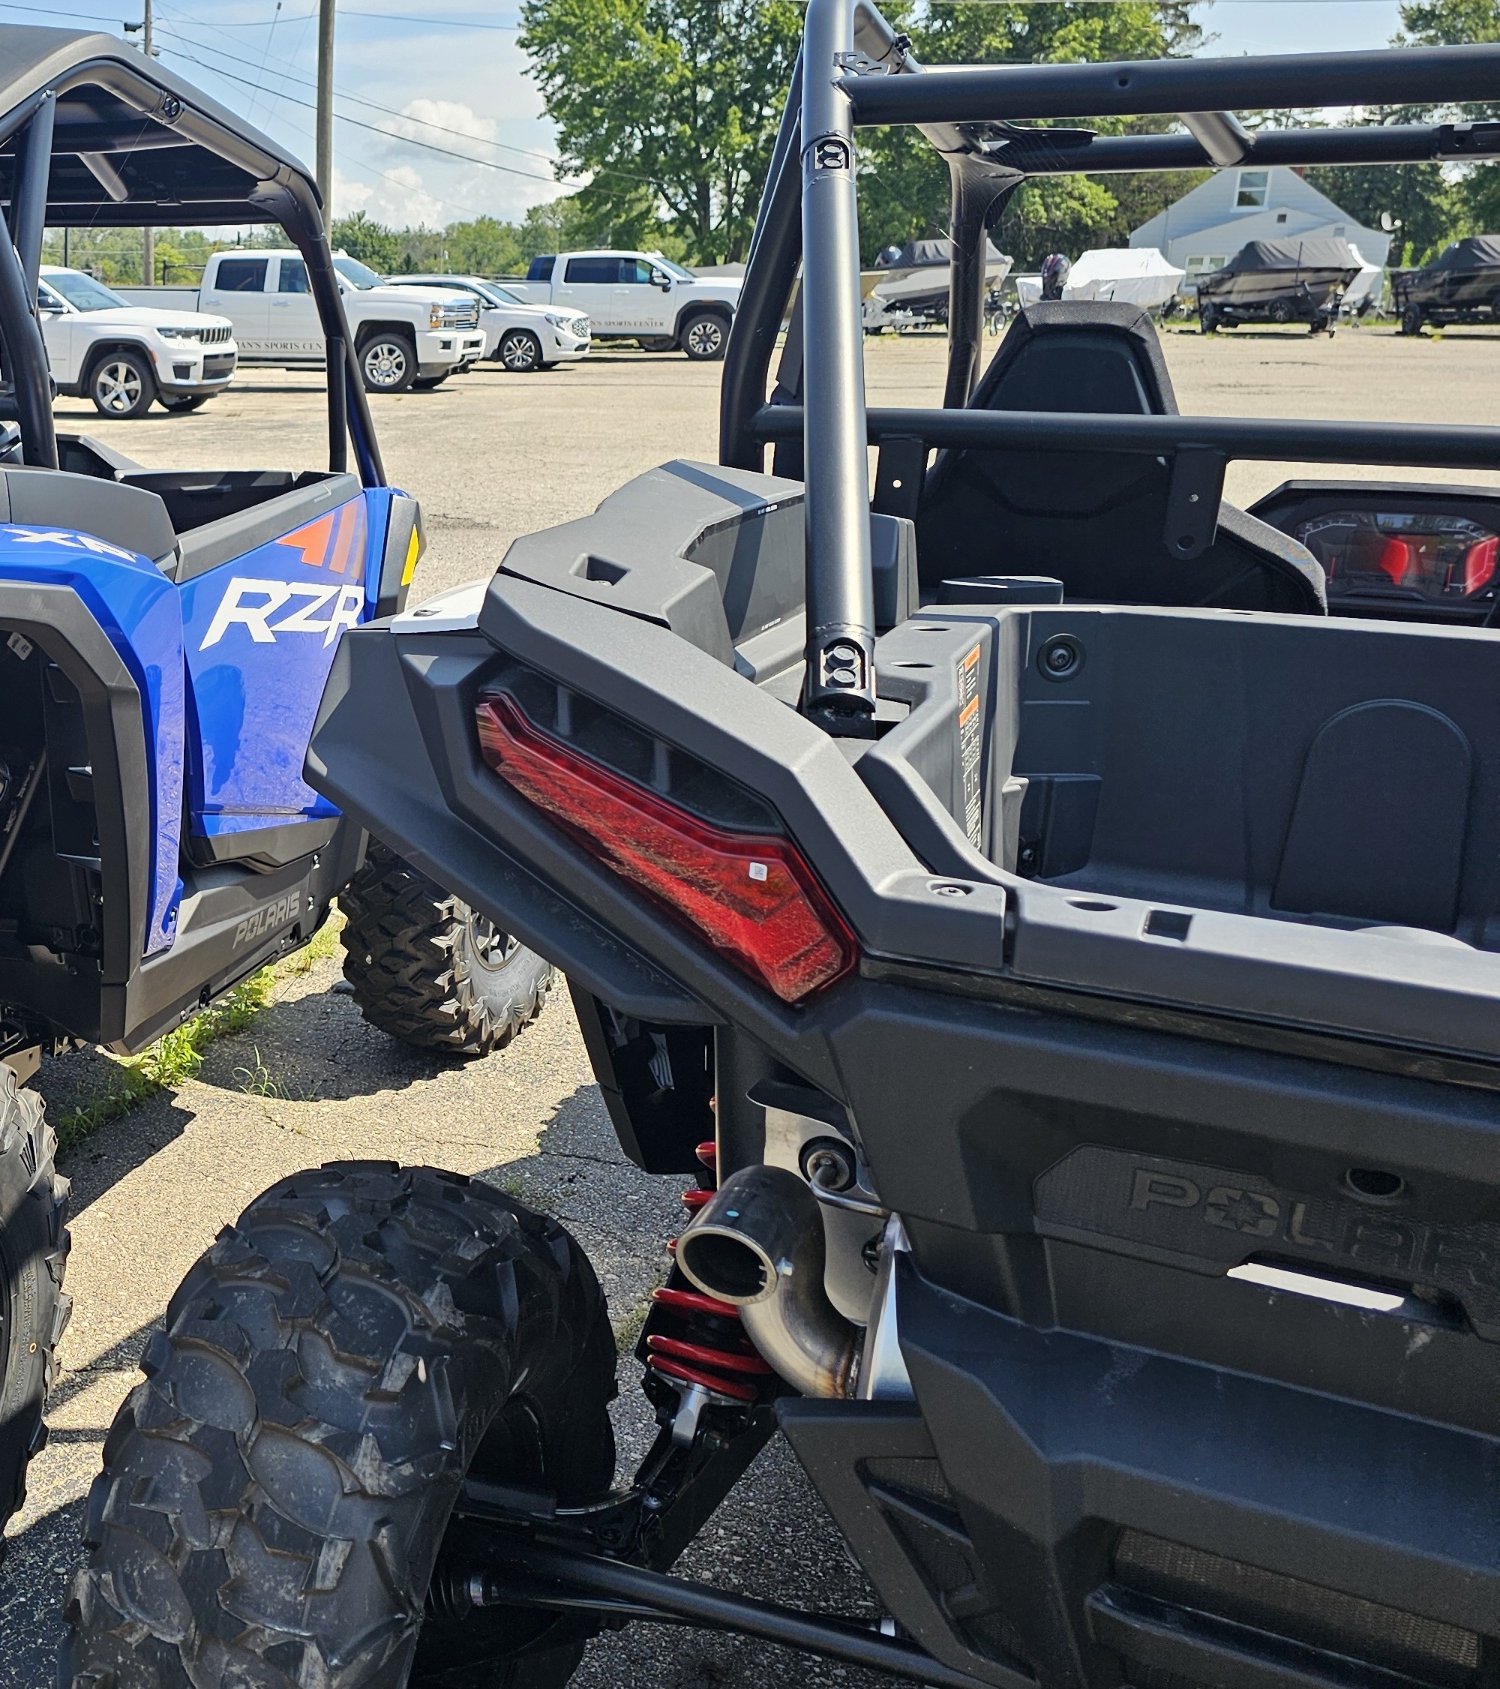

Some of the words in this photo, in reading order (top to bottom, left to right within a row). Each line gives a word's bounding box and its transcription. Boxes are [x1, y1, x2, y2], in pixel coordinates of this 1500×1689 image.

[264, 341, 300, 350] SPORTS
[198, 577, 365, 652] RZR
[232, 890, 300, 950] POLARIS
